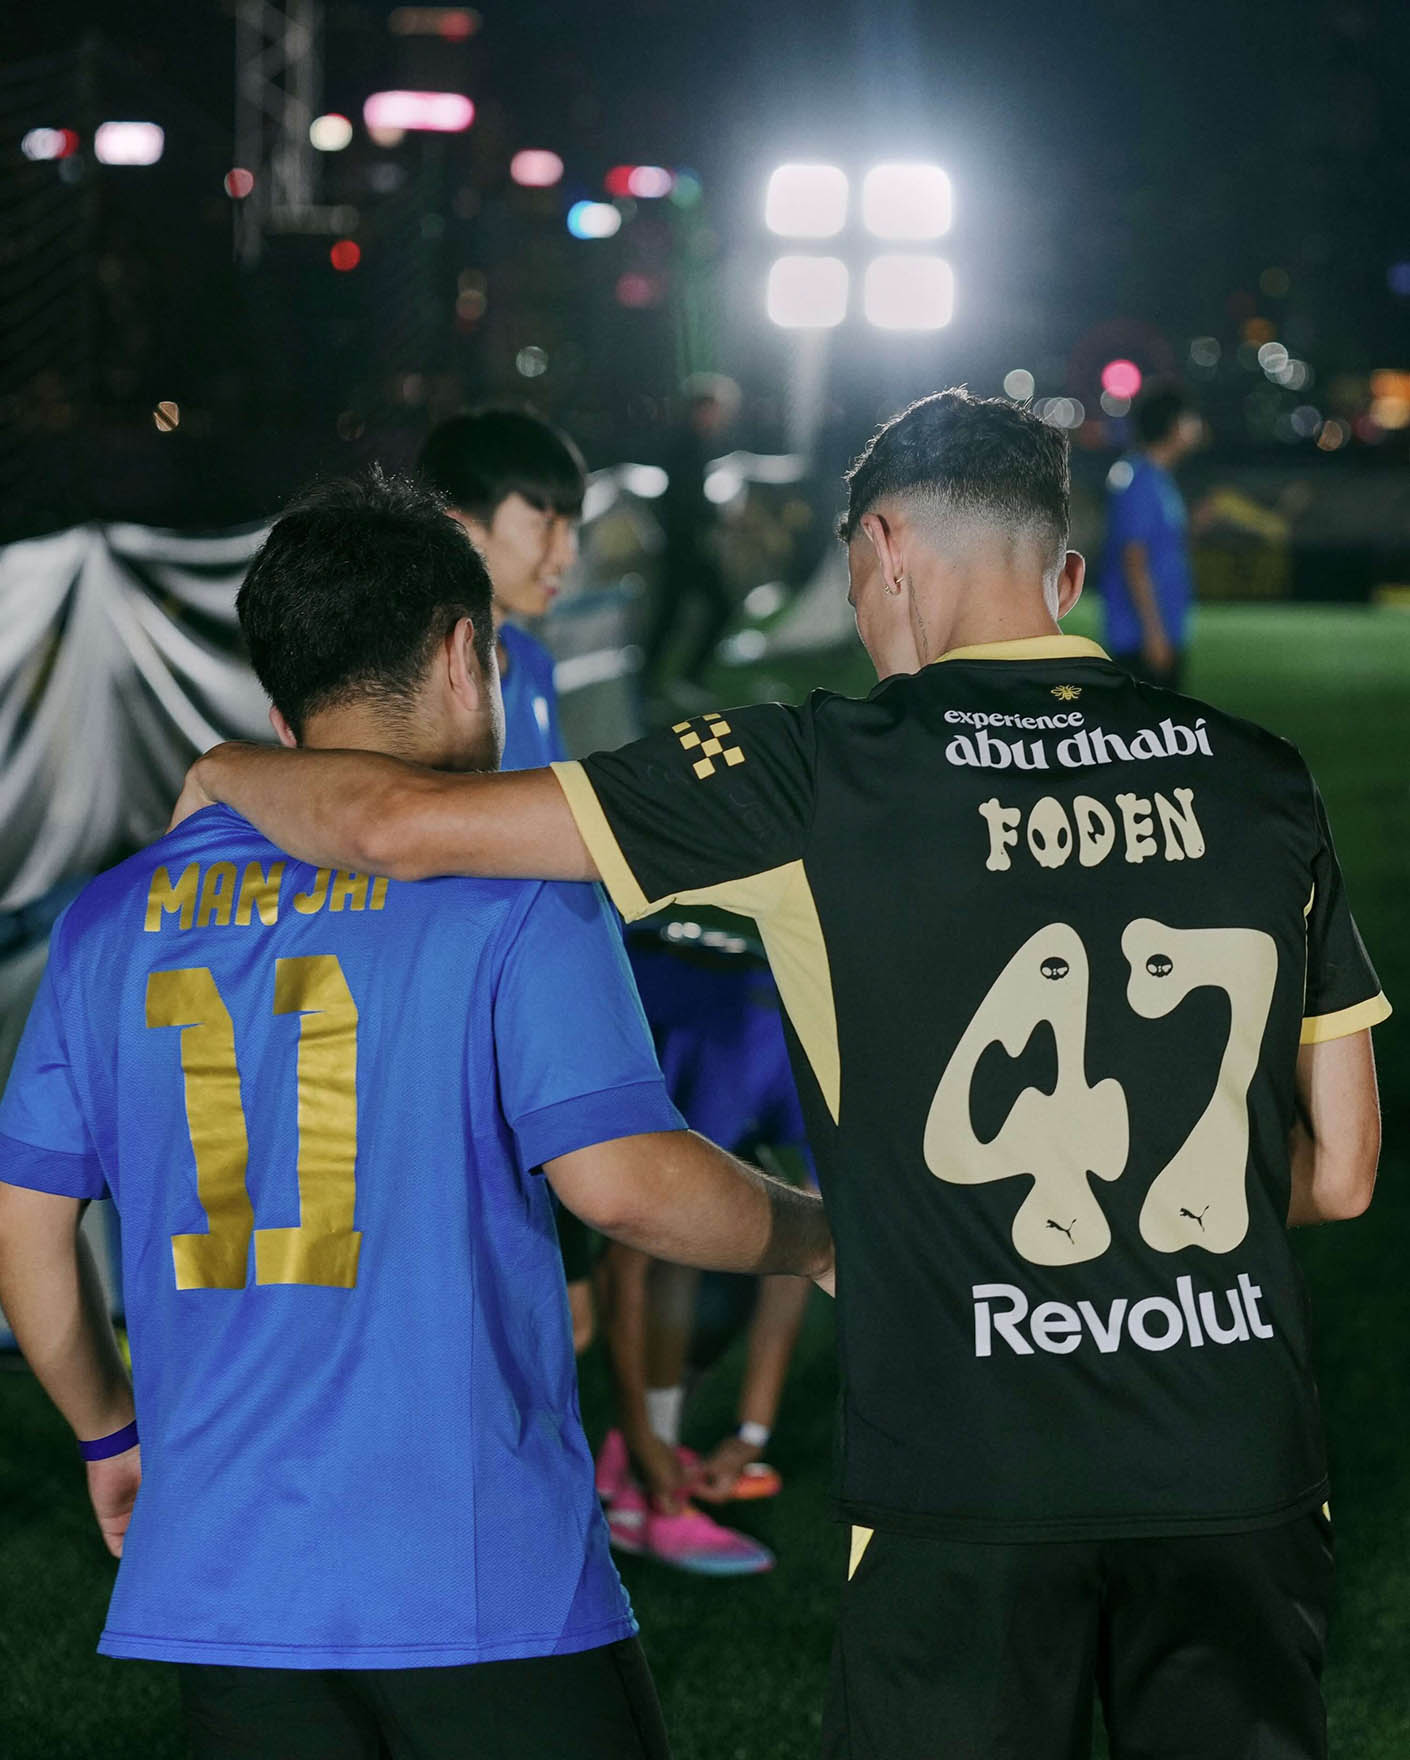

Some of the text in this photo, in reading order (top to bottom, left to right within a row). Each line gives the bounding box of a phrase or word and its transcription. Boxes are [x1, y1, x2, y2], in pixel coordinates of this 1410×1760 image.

[944, 710, 1085, 730] experience
[945, 718, 1214, 769] abu dhabi
[978, 787, 1205, 872] FODEN
[143, 861, 287, 932] MAN
[145, 954, 363, 1291] 11
[923, 917, 1279, 1267] 47
[972, 1273, 1274, 1357] Revolut
